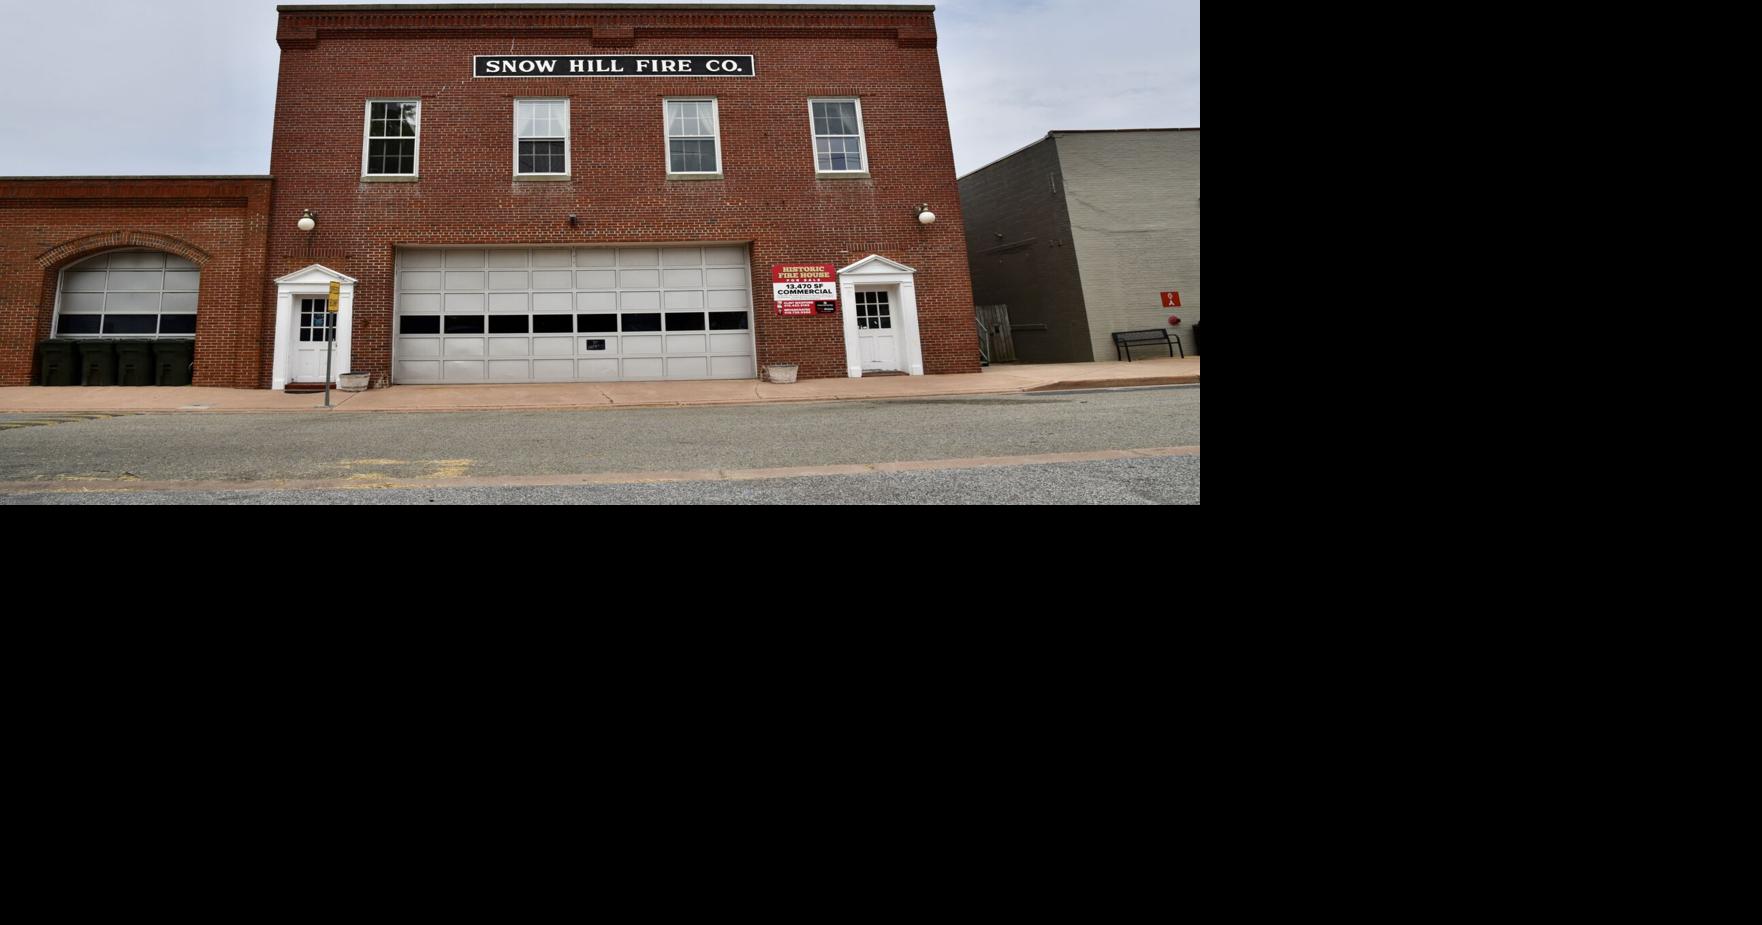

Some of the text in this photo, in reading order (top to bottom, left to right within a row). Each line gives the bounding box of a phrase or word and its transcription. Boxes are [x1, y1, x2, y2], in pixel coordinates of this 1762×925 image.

[486, 60, 743, 73] SNOW HILL FIRE CO.
